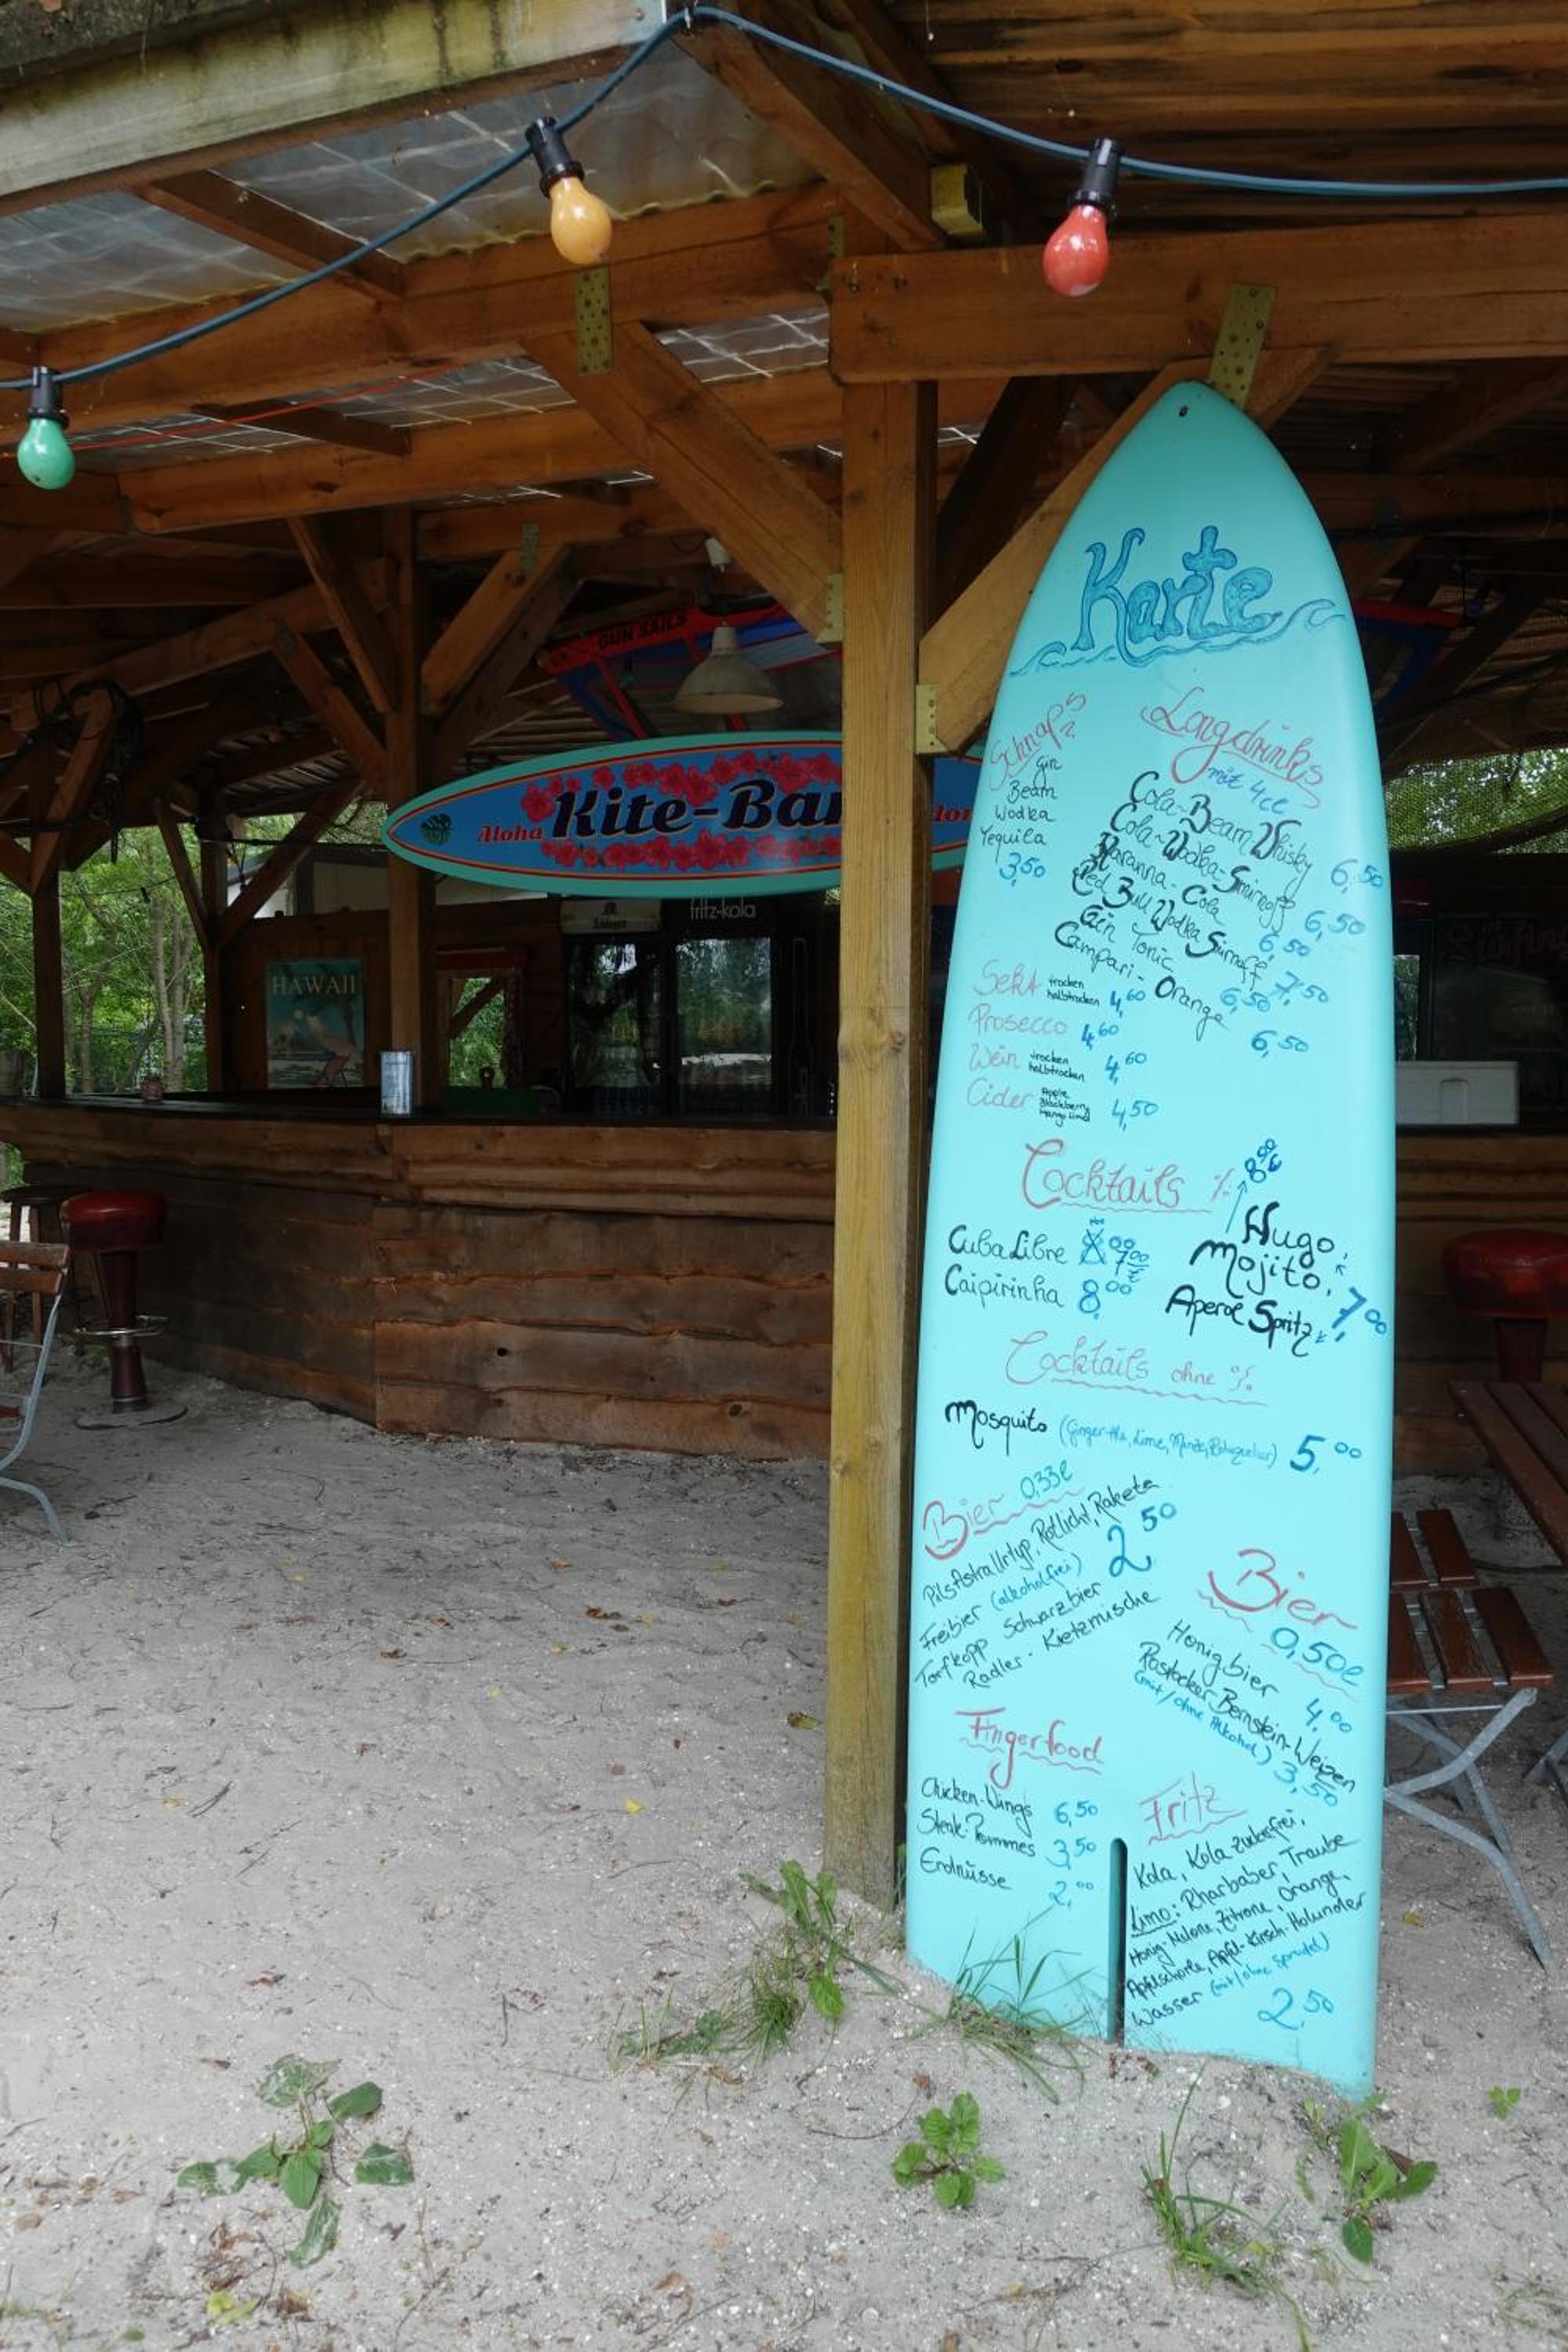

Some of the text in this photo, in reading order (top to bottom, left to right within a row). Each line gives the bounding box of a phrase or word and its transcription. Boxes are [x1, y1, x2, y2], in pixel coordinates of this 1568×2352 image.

[1071, 524, 1282, 667] Karte
[598, 626, 633, 650] GUN
[1033, 755, 1062, 789] Gin
[1007, 780, 1058, 804] Beam
[995, 806, 1056, 822] Wodka
[477, 825, 544, 842] Aloha
[689, 898, 756, 920] fritz-kola
[1102, 877, 1152, 914] Bull
[1131, 922, 1173, 972] Tonic
[272, 976, 357, 994] HAWAII
[967, 1004, 1067, 1036] Prosecco
[969, 1043, 1022, 1071] Wein
[966, 1077, 1033, 1109] Cider
[1022, 1139, 1185, 1208] Cocktails
[949, 1225, 1009, 1259] Cuba
[1008, 1230, 1067, 1265] Libre
[945, 1263, 1065, 1310] Caipirinha
[1007, 1330, 1149, 1385] Cocktails
[1171, 1361, 1217, 1386] ohne
[945, 1399, 1048, 1456] Mosquito
[923, 1494, 1004, 1561] Bier
[1208, 1548, 1358, 1631] Bier
[920, 1605, 983, 1651] Freibier
[954, 1707, 1105, 1790] Fingerfood
[1140, 1769, 1235, 1838] Fritz
[920, 1846, 1014, 1890] Erdnüsse
[1279, 1833, 1360, 1867] Traube
[1131, 1992, 1203, 2027] Wasser
